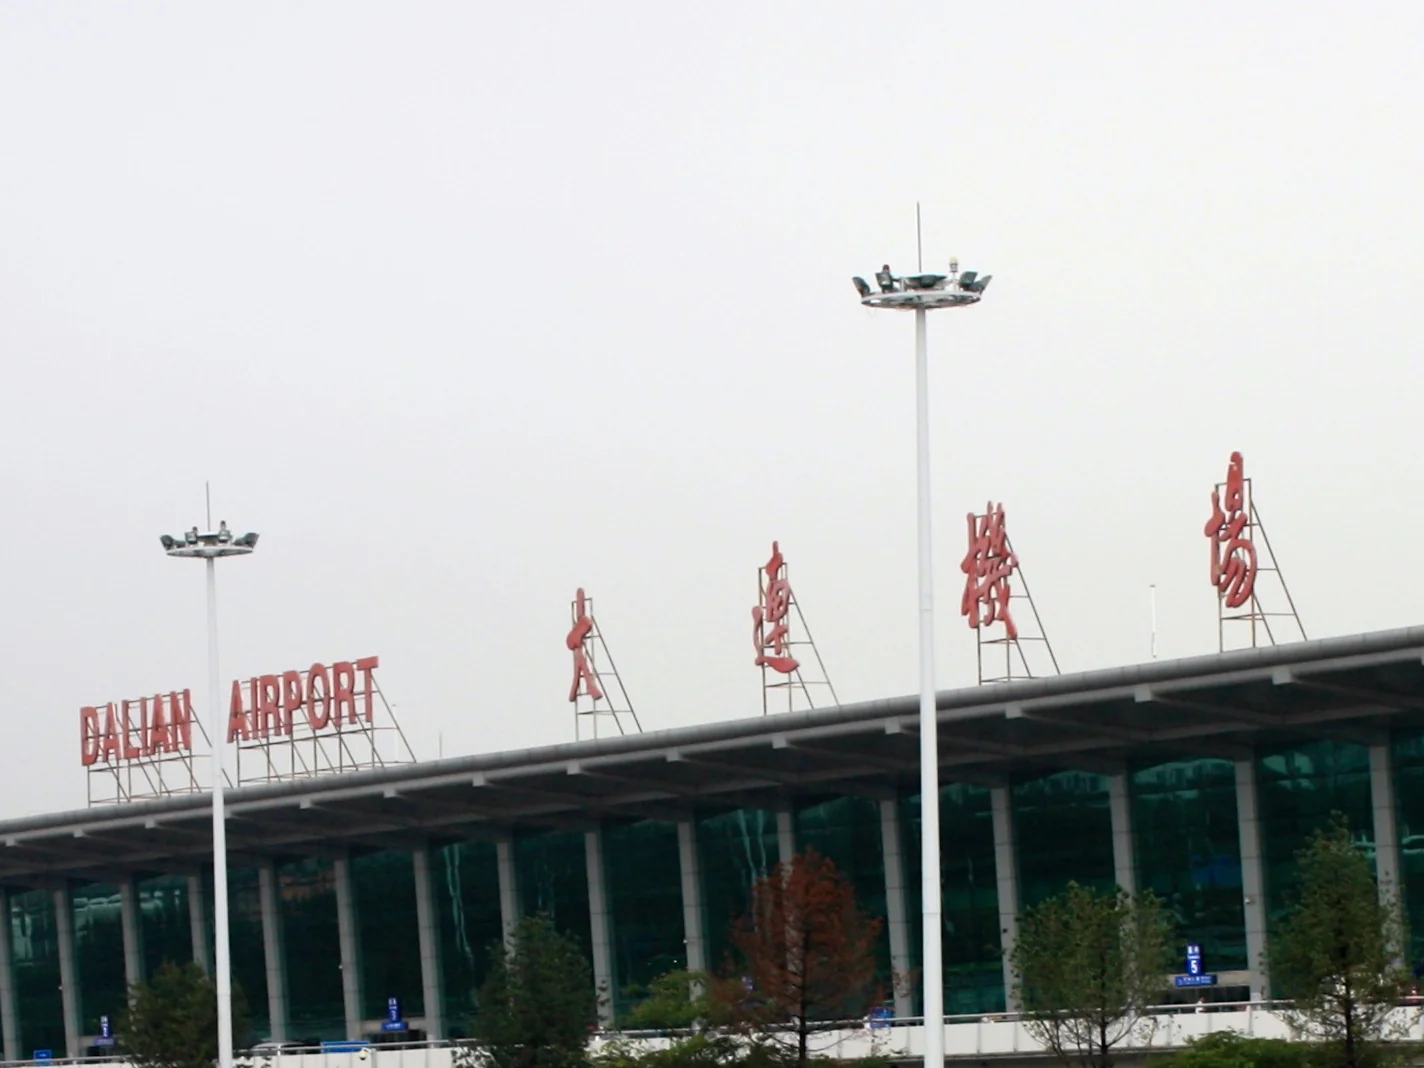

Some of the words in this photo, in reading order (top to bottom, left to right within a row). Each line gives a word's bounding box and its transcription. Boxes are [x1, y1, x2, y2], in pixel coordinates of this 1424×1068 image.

[80, 688, 192, 767] DALIAN
[227, 655, 379, 743] AIRPORT
[1190, 959, 1198, 974] 5
